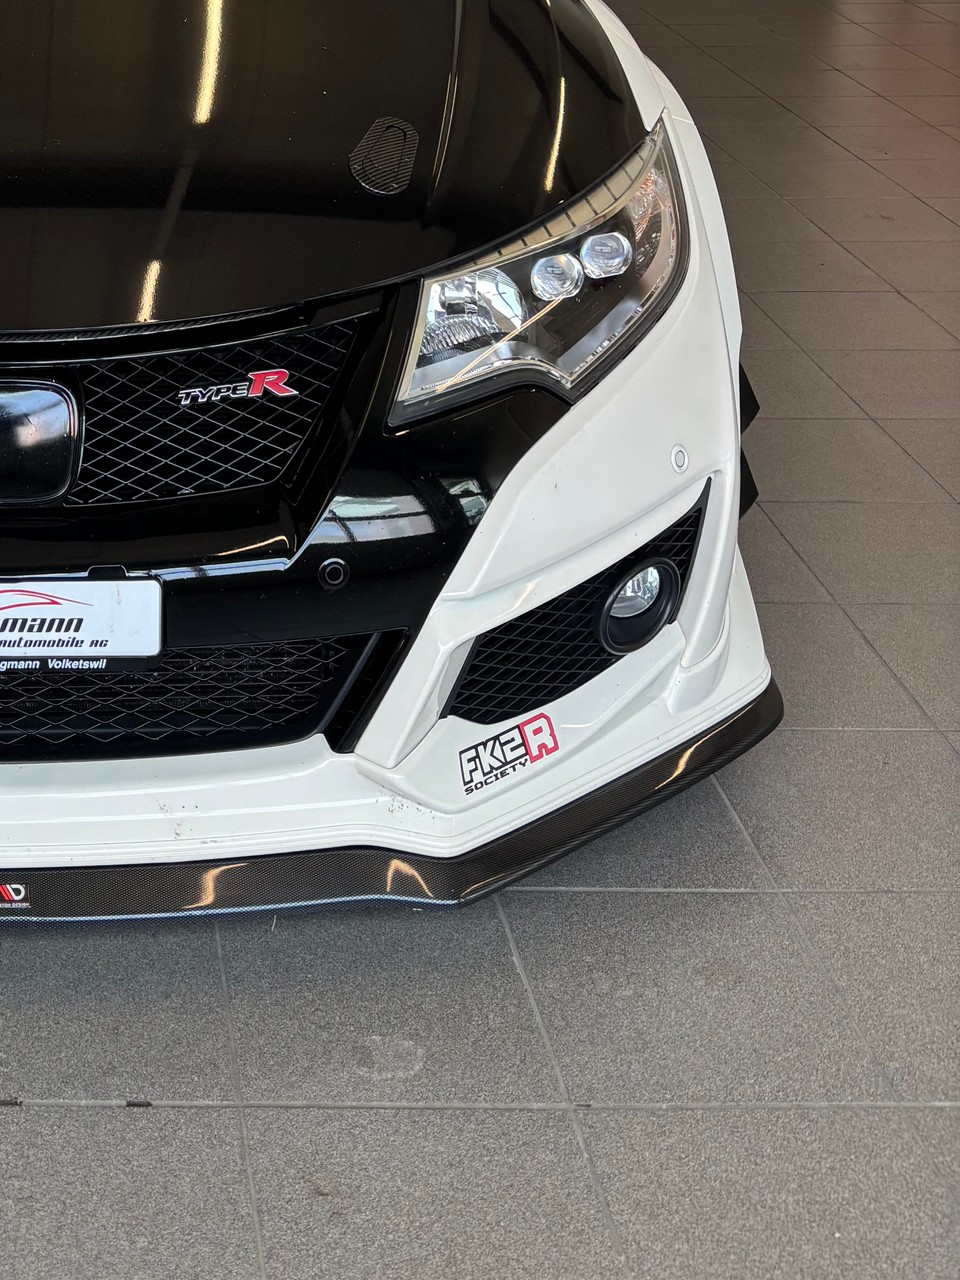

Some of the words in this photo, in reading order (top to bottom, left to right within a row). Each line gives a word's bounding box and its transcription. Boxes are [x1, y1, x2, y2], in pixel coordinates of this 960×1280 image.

[178, 382, 249, 405] TYPE
[247, 368, 299, 397] R
[47, 658, 107, 670] Volketswil
[464, 758, 528, 796] SOCIETY
